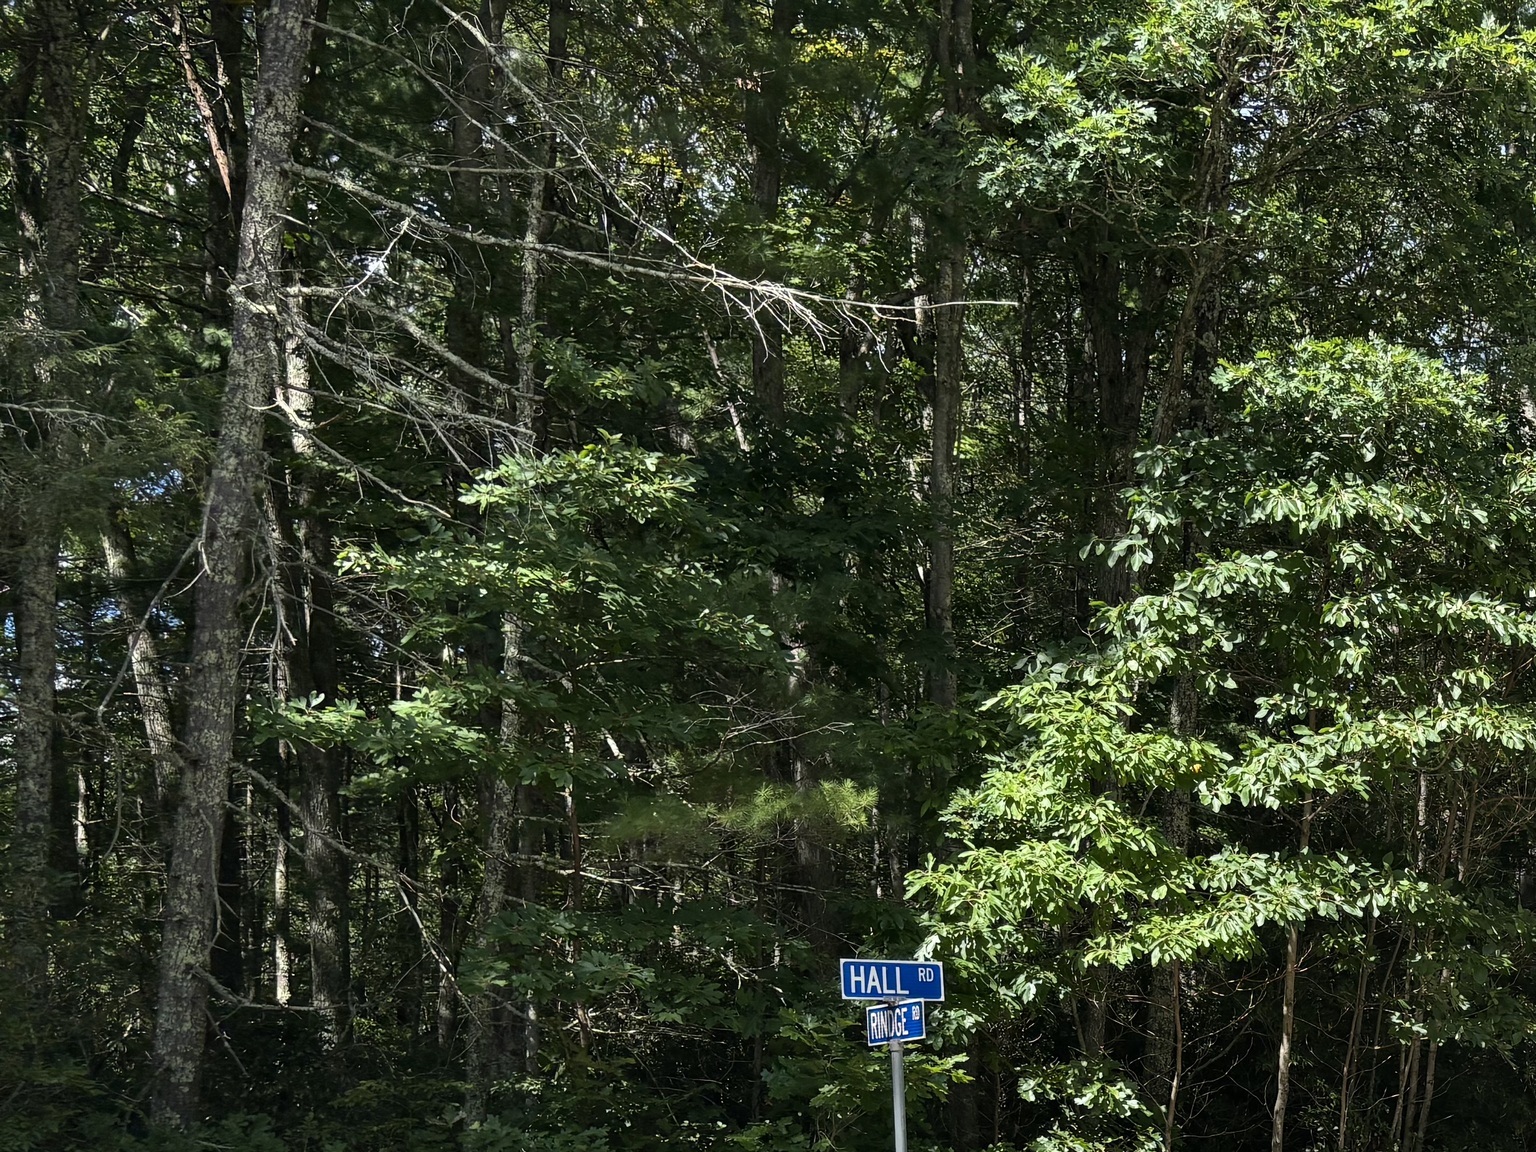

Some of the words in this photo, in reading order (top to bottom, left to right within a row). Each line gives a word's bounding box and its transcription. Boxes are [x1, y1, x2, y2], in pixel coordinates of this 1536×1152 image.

[850, 965, 909, 995] HALL
[918, 967, 934, 983] RD
[870, 1007, 909, 1040] RINDGE
